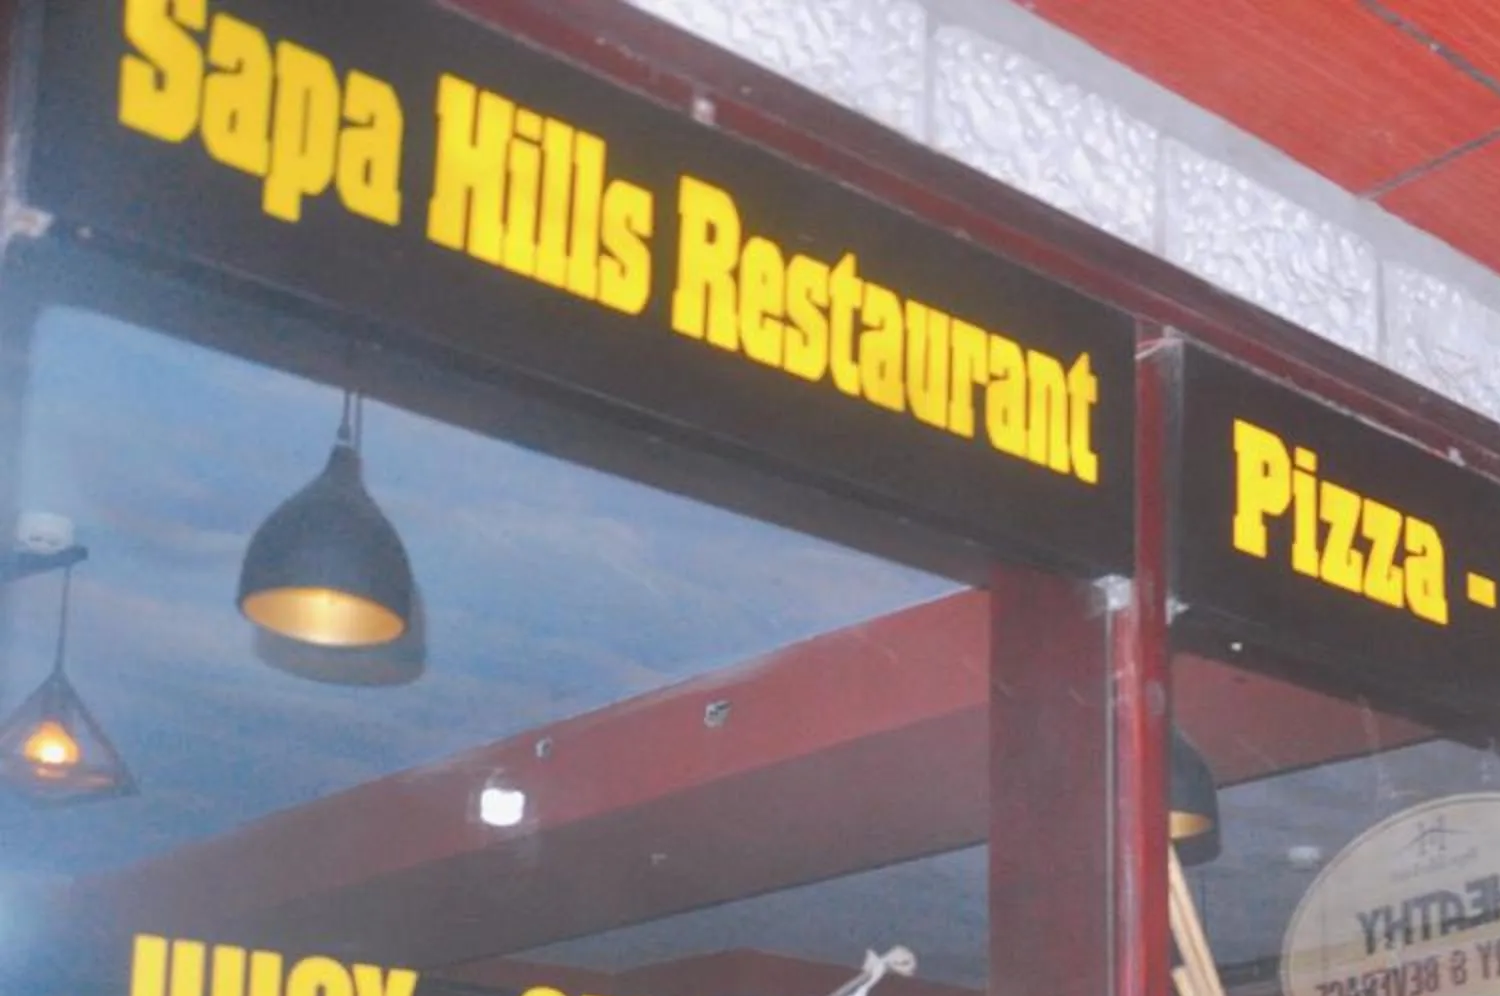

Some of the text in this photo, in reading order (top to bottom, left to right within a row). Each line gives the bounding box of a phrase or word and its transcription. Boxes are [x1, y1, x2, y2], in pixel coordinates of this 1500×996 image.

[117, 0, 1100, 486] Sapa Hills Restaurant
[1231, 418, 1449, 625] Pizza
